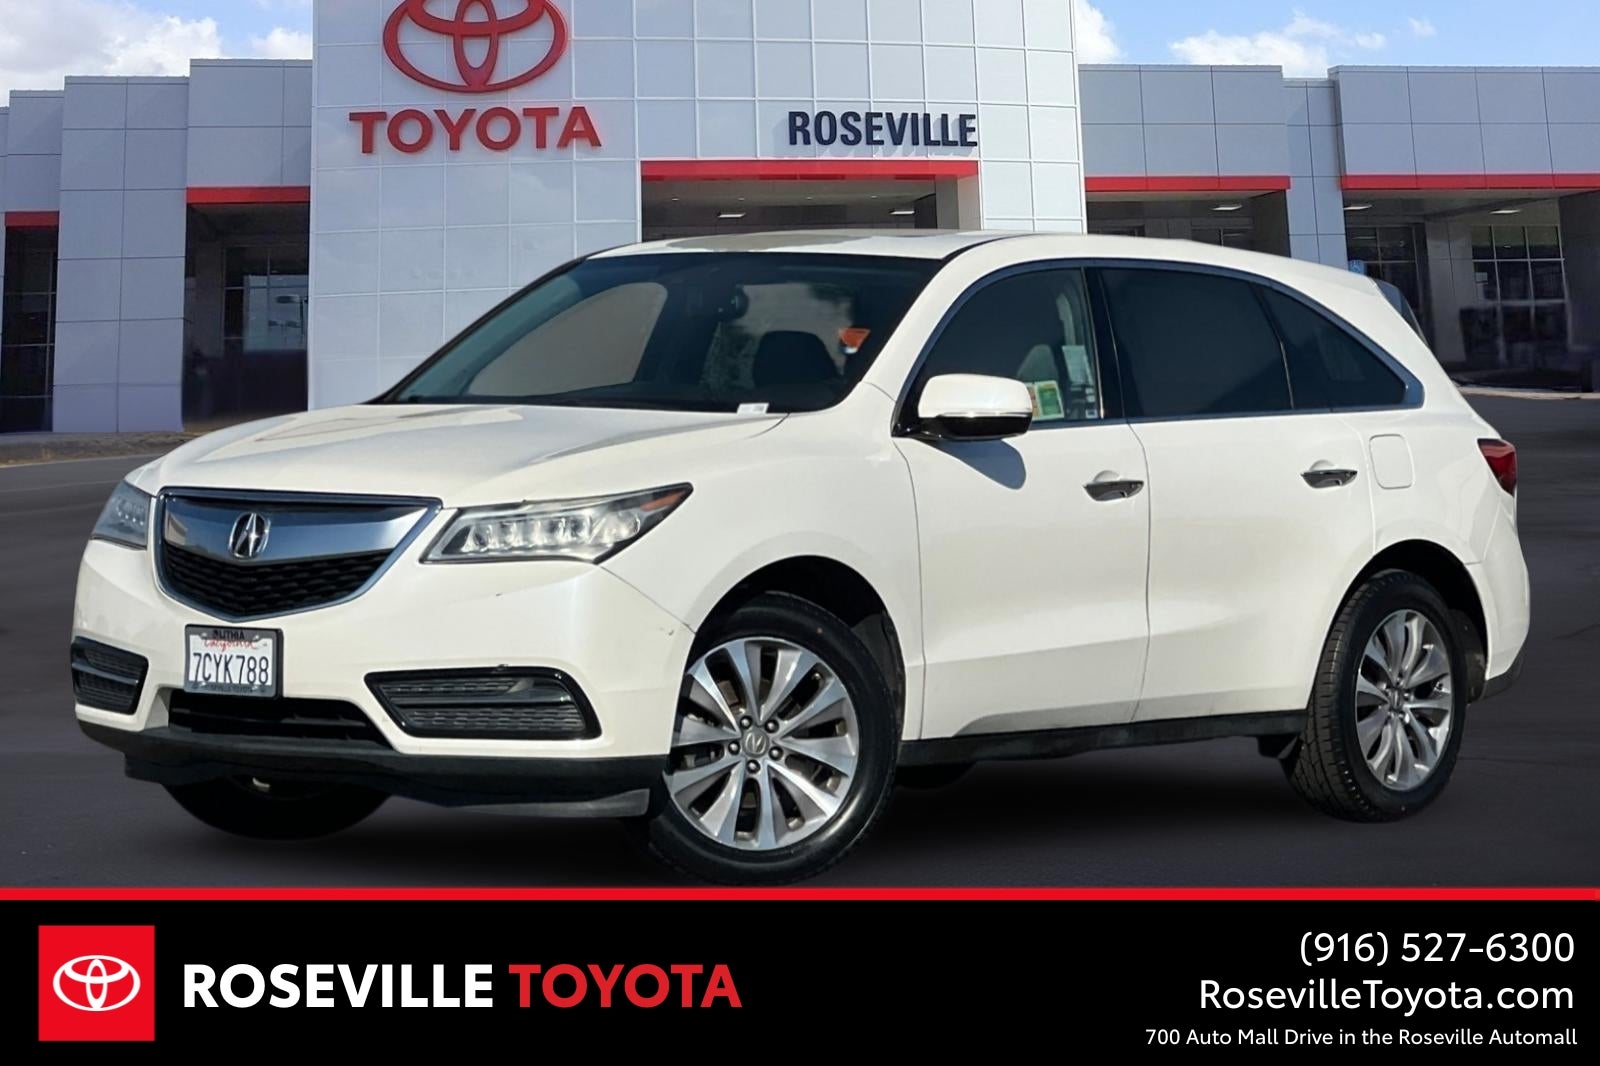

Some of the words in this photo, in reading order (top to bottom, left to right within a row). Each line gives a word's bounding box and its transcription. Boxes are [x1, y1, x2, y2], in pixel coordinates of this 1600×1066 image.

[349, 106, 602, 153] TOYOTA
[788, 110, 978, 147] ROSEVILLE
[193, 652, 269, 685] 7CYK788
